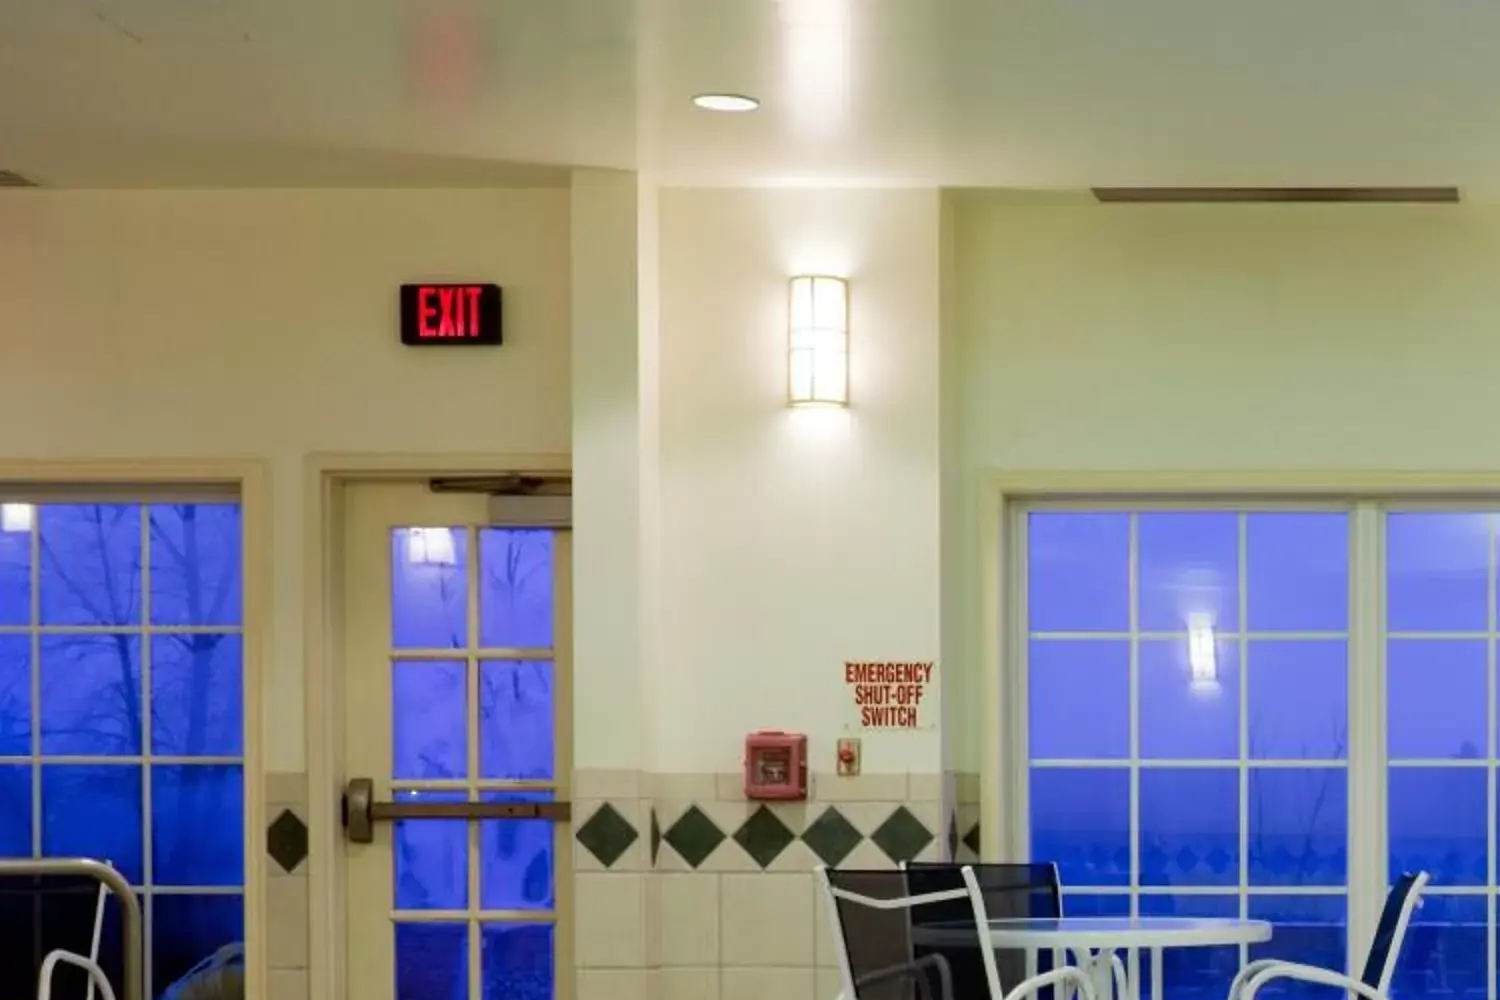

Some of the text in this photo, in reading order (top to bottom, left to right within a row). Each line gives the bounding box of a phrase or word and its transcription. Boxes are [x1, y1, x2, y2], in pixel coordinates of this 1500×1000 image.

[418, 286, 482, 337] EXIT
[844, 661, 934, 684] EMERGENCY
[854, 684, 924, 705] SHUT-OFF
[860, 705, 917, 728] SWITCH
